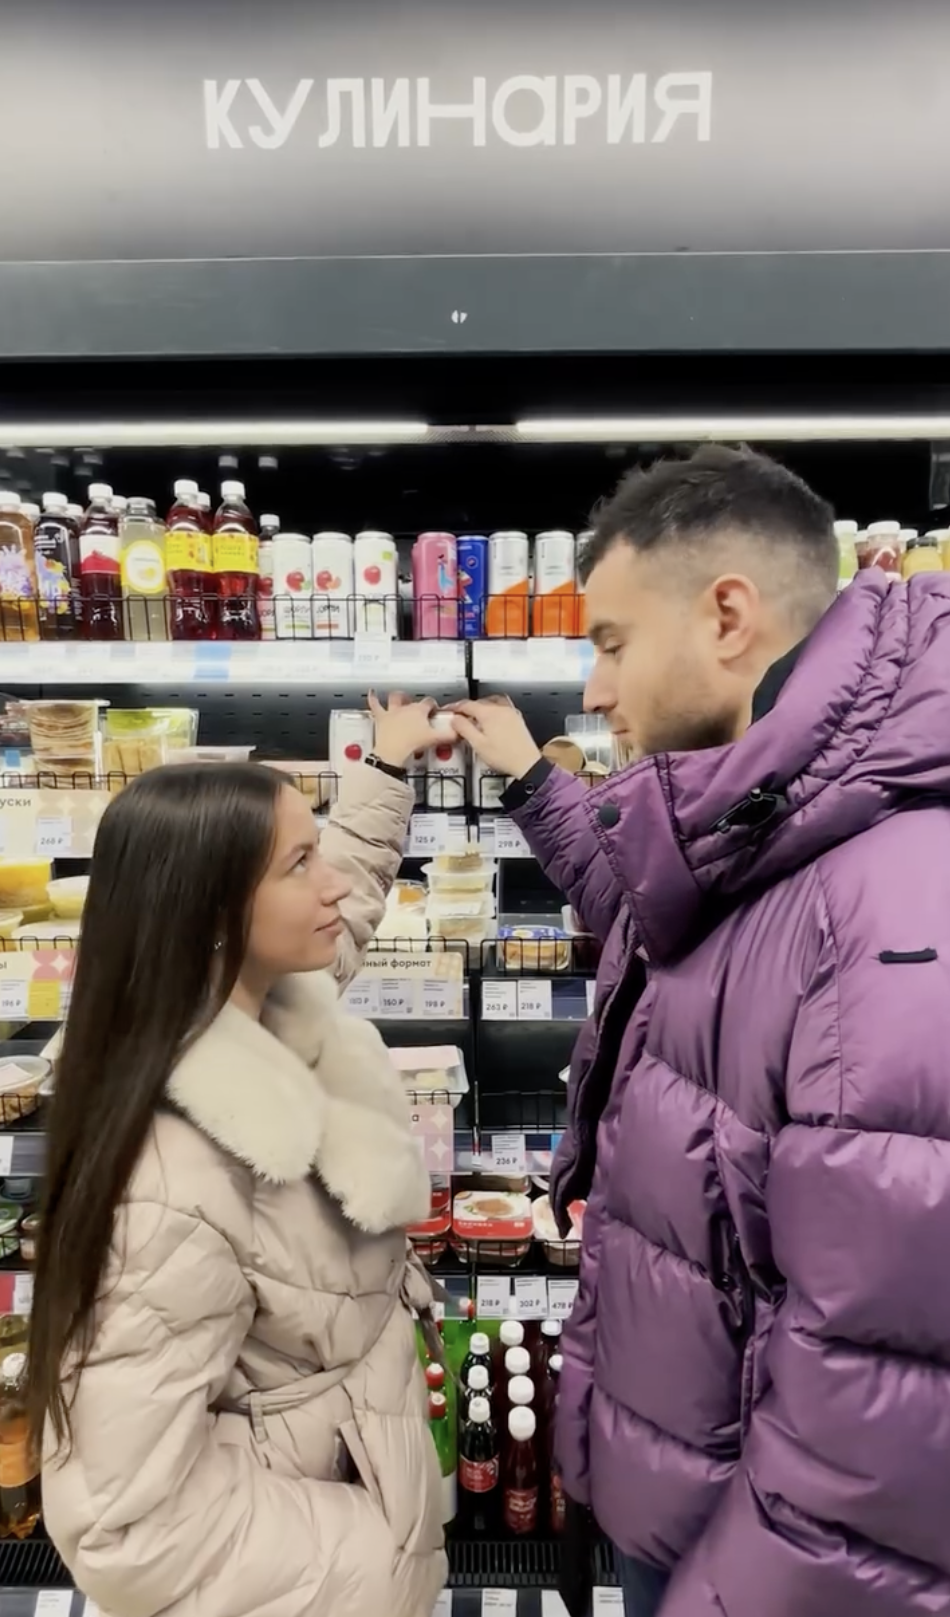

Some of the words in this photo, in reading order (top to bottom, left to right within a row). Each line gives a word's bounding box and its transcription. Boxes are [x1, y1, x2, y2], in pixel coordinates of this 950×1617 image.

[203, 70, 713, 150] КУЛИНАРИЯ
[0, 798, 32, 810] уски
[498, 840, 513, 848] 298
[361, 957, 388, 968] ный
[390, 957, 431, 969] формат
[496, 1157, 511, 1165] 236
